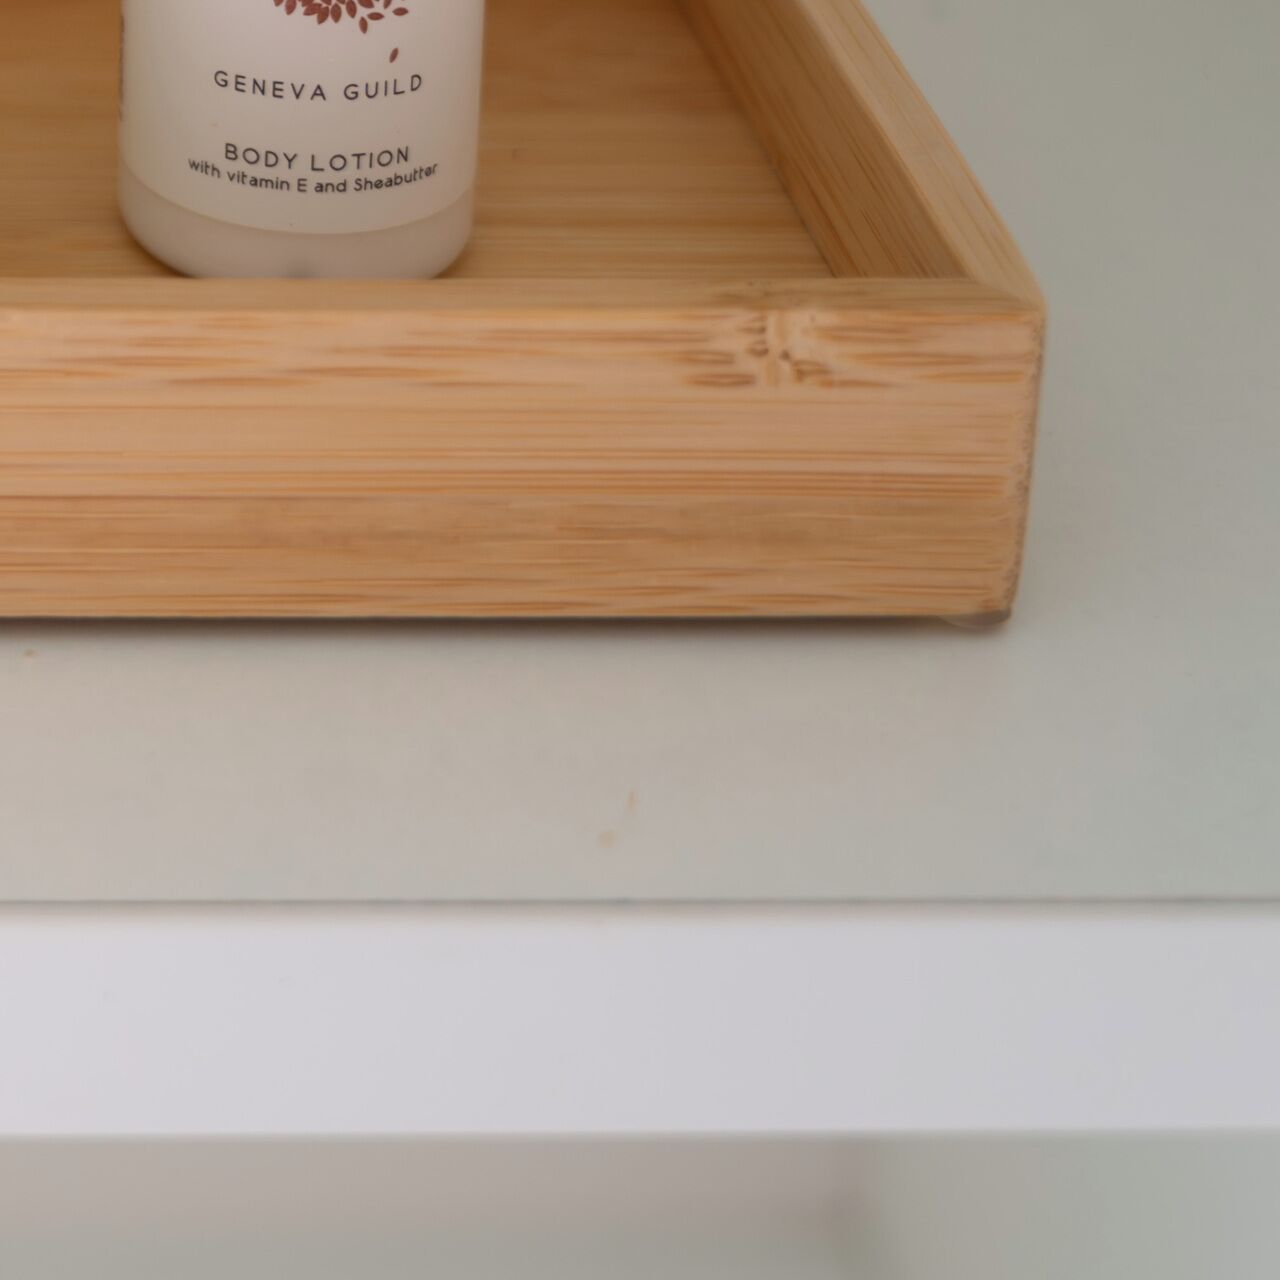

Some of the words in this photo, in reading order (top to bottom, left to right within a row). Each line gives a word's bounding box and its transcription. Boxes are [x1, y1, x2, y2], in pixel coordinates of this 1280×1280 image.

[214, 71, 326, 101] GENEVA
[344, 74, 422, 101] GUILD
[225, 143, 298, 170] BODY
[311, 146, 409, 172] LOTION
[188, 158, 221, 178] with
[227, 170, 290, 191] vitamin
[298, 179, 307, 192] E
[315, 179, 347, 193] and
[354, 163, 438, 192] Sheabutter
